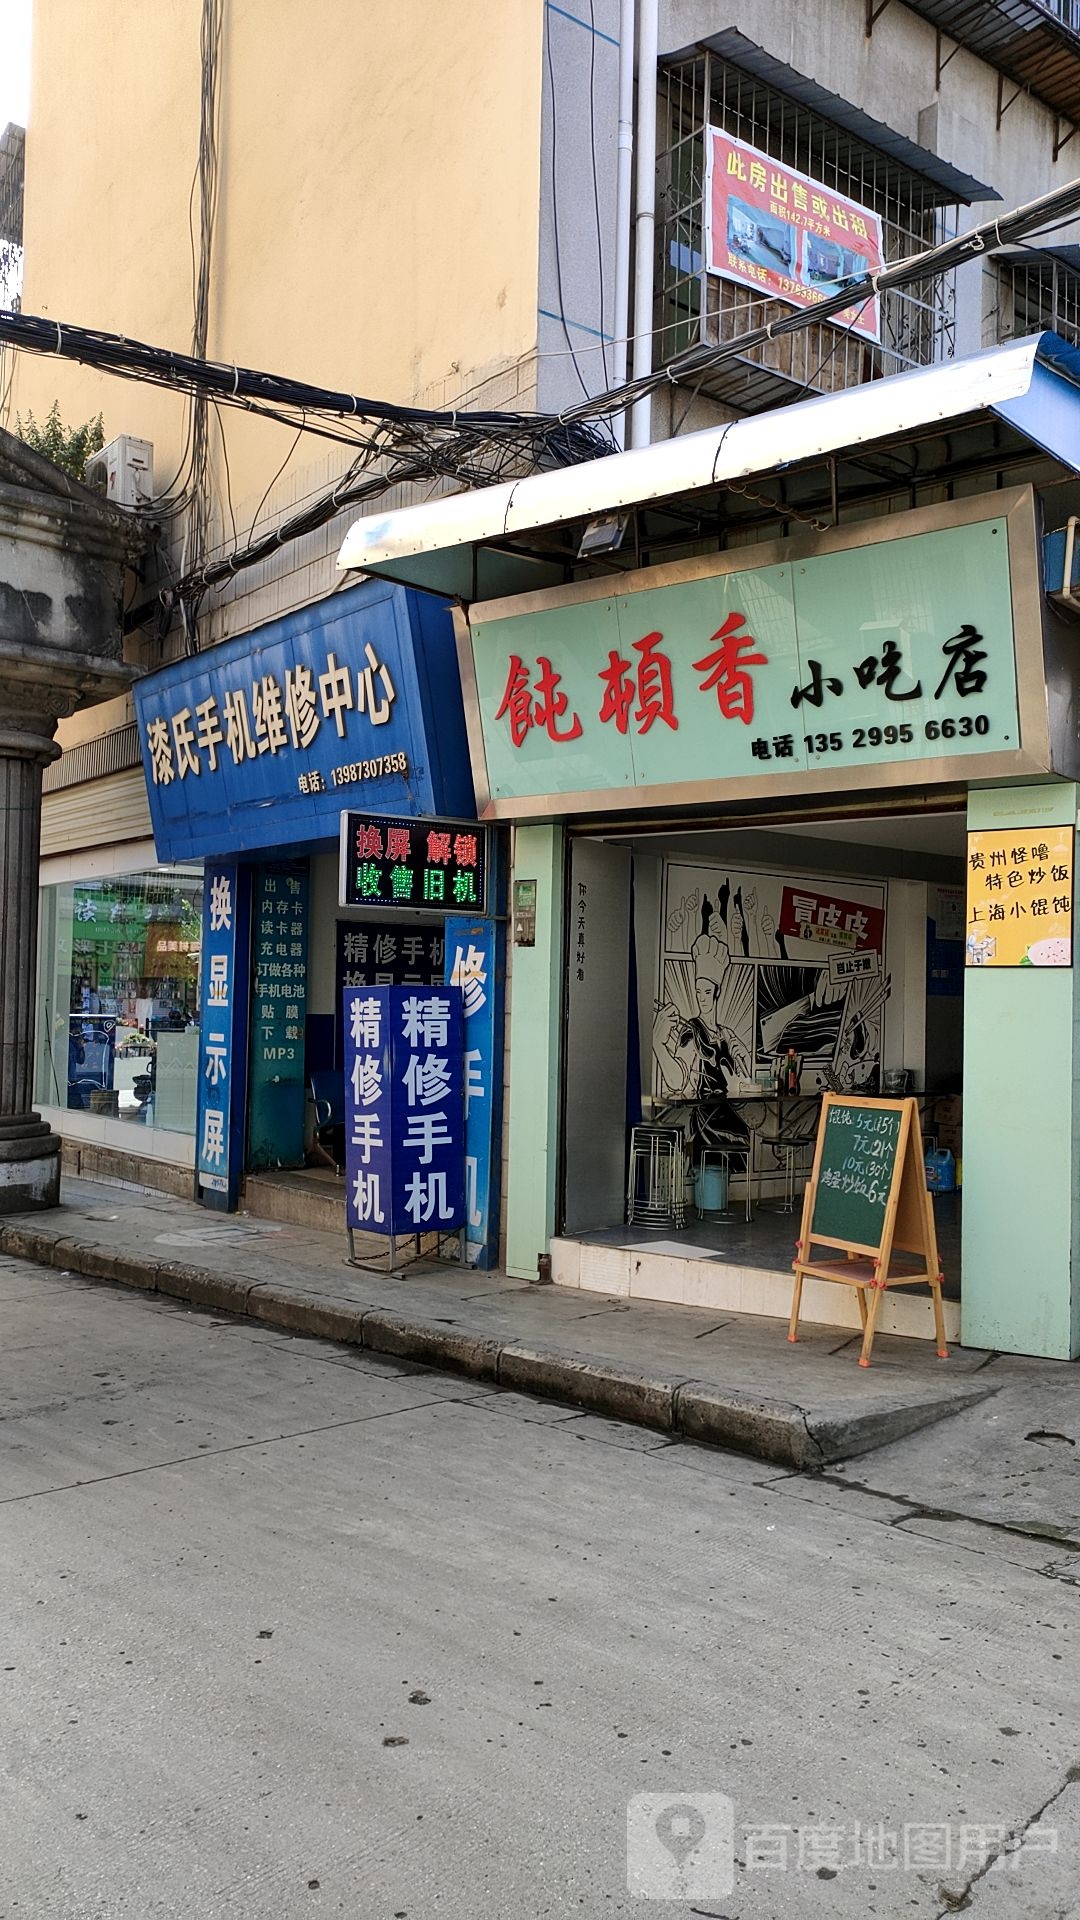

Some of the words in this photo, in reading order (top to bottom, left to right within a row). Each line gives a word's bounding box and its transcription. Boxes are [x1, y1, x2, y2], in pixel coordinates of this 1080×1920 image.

[726, 150, 868, 240] 此房出售或出租
[790, 625, 988, 712] 小吃店
[147, 642, 395, 786] 漆氏手机维修中心
[751, 734, 794, 760] 电话
[804, 732, 843, 754] 135
[852, 724, 913, 748] 2995
[924, 714, 990, 741] 6630
[356, 824, 411, 862] 换屏
[426, 831, 477, 867] 解锁
[969, 844, 1050, 871] 贵州怪噜
[264, 878, 300, 895] 出售
[356, 862, 476, 902] 收售旧机
[985, 865, 1069, 891] 特色炒饭
[262, 900, 303, 916] 内存卡
[968, 896, 1072, 924] 上海小馄饨
[261, 921, 302, 936] 读卡器
[261, 942, 303, 957] 充电器
[257, 963, 306, 978] 订做各种
[257, 984, 305, 999] 手机电池
[202, 876, 231, 1167] 换显示屏
[261, 1005, 299, 1020] 贴膜
[261, 1026, 300, 1041] 下载
[263, 1048, 295, 1060] MP3
[350, 997, 385, 1224] 精修手机
[402, 996, 455, 1224] 精修手机
